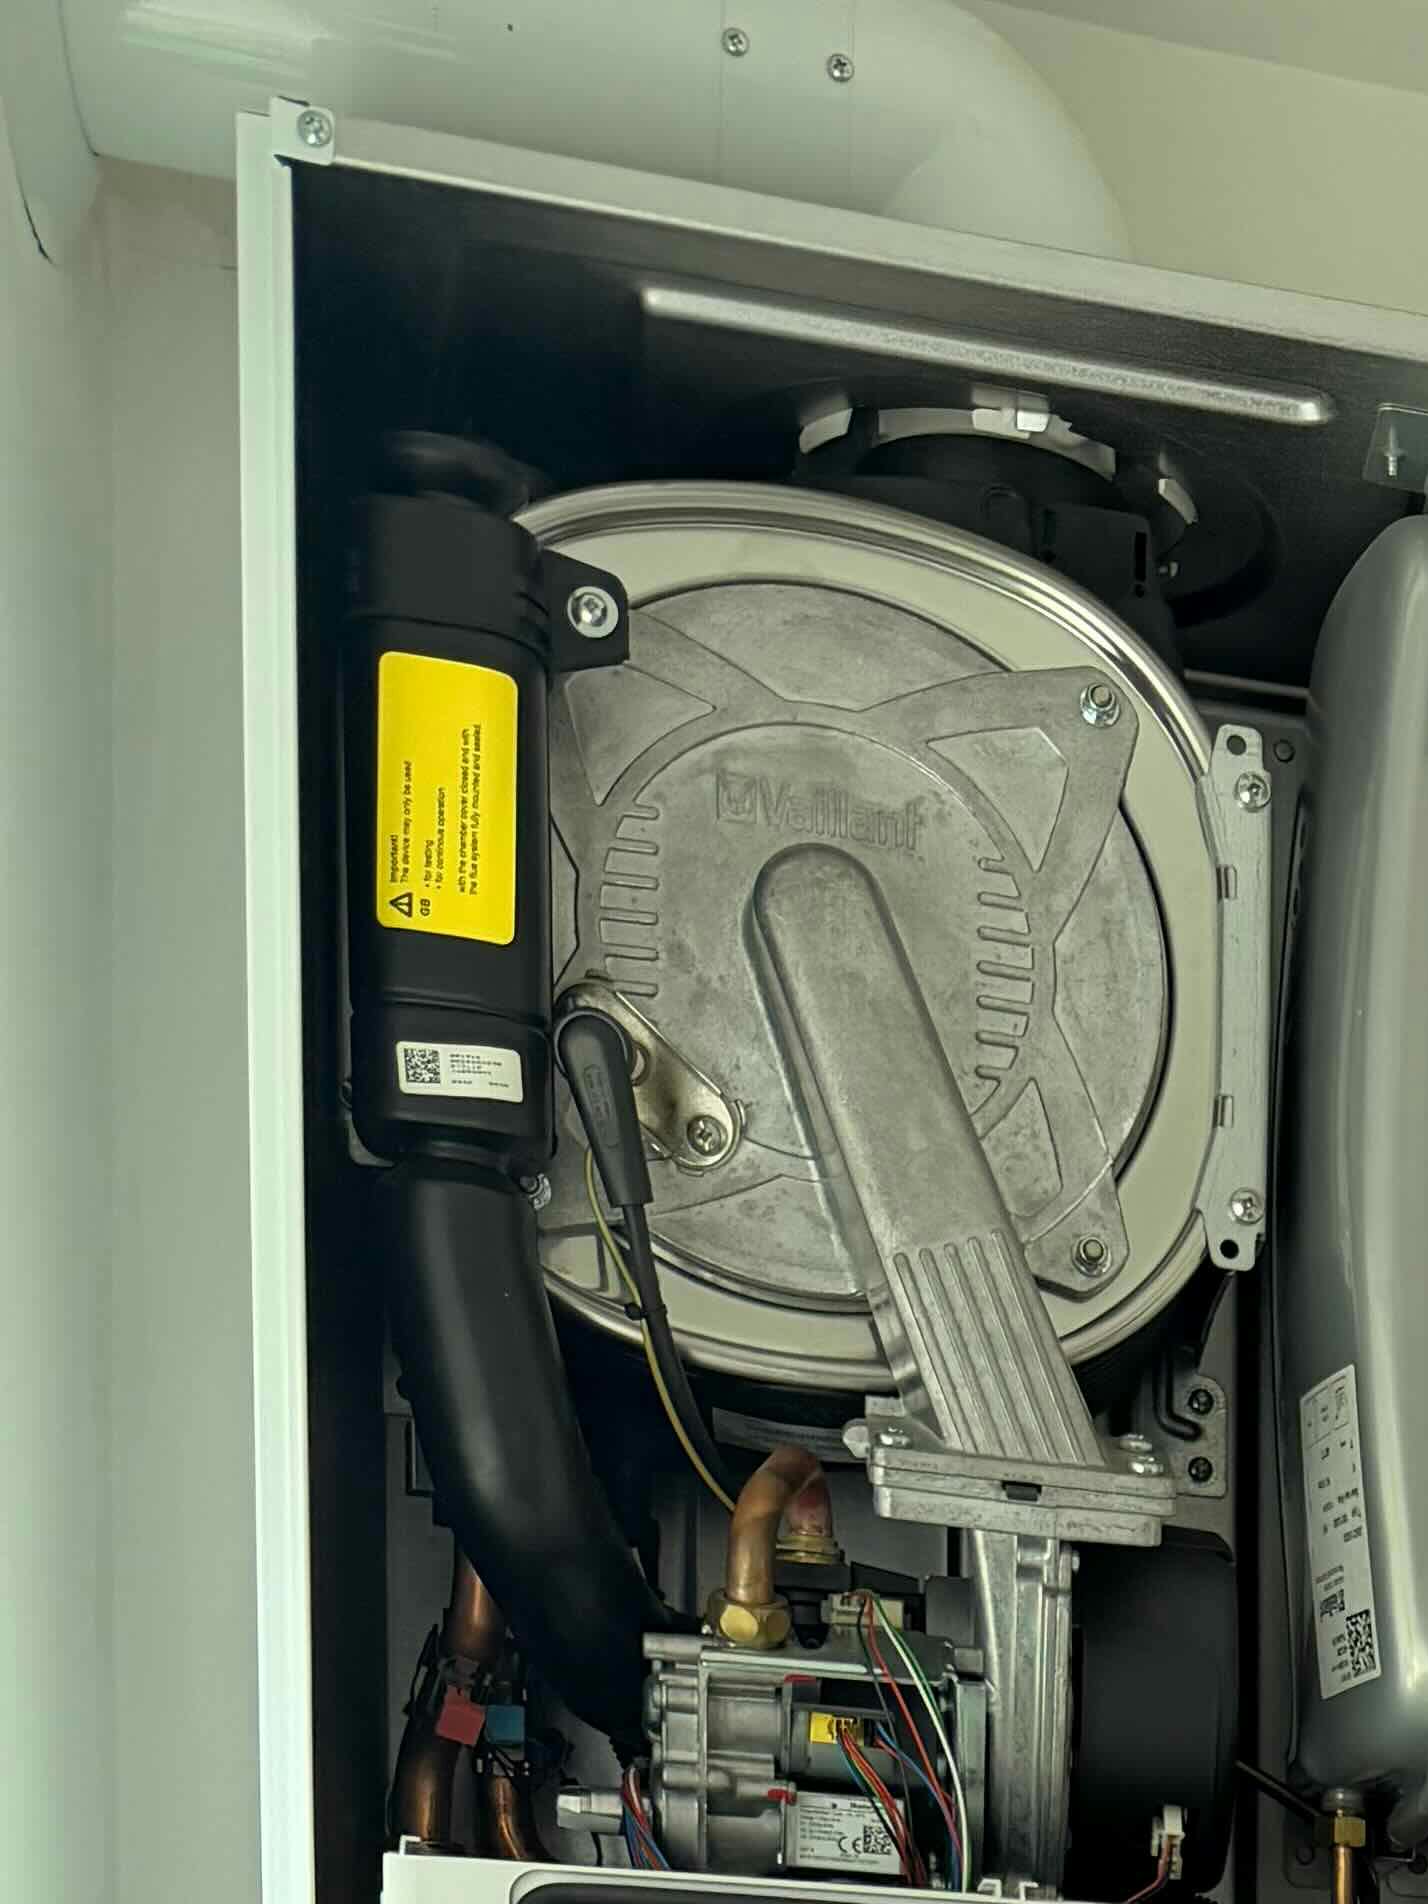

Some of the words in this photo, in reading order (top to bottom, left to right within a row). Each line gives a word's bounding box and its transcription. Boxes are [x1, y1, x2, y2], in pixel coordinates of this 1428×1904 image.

[461, 748, 469, 764] and
[472, 755, 480, 770] and
[403, 784, 411, 795] be
[403, 797, 412, 815] only
[437, 788, 445, 826] operation
[758, 776, 925, 850] Vaillant
[403, 817, 412, 835] may
[402, 838, 410, 865] device
[424, 840, 433, 867] testing
[401, 868, 409, 883] The
[458, 860, 466, 874] the
[435, 872, 443, 883] for
[458, 876, 466, 893] with
[420, 899, 430, 916] GB
